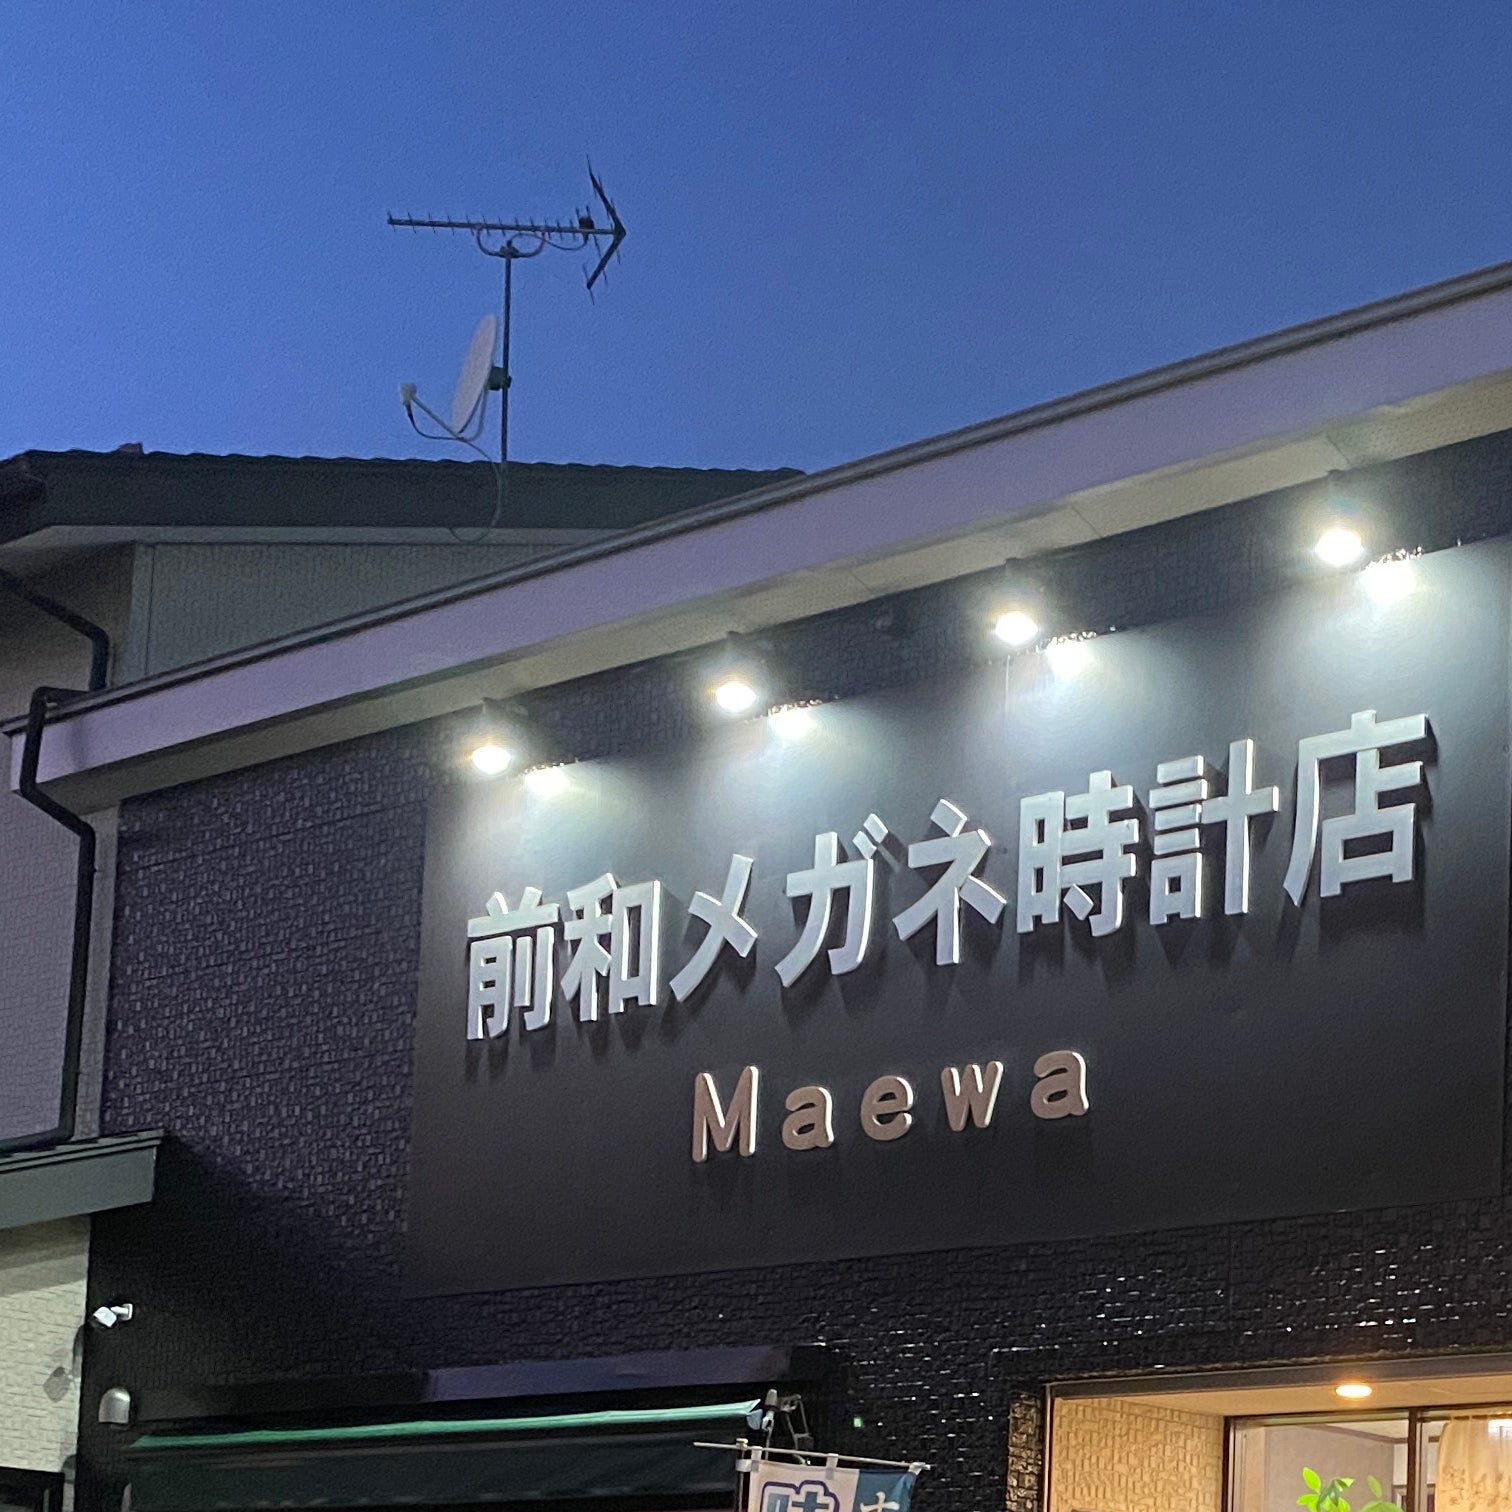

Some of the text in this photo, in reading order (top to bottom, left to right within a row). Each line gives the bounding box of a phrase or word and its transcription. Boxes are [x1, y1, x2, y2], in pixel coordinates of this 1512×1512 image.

[467, 709, 1429, 1041] 前和メガネ時計店
[691, 1049, 1090, 1164] Maewa
